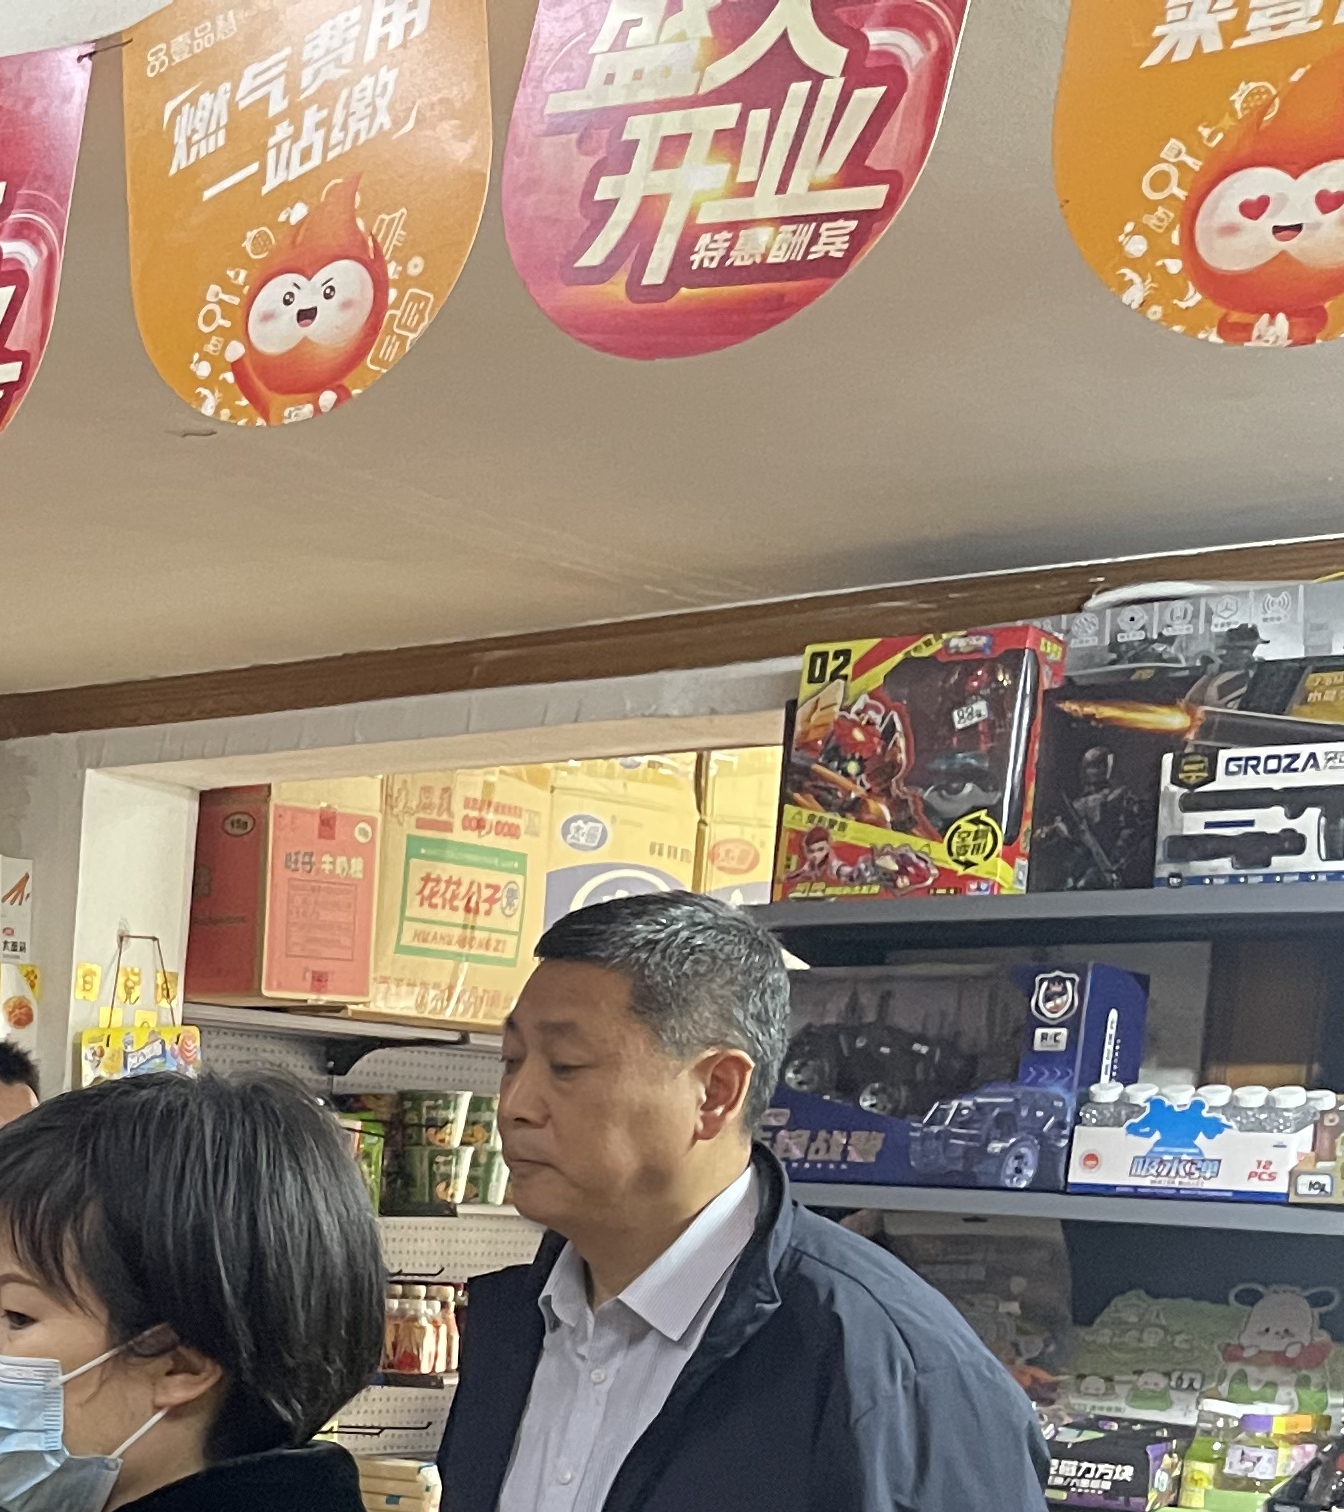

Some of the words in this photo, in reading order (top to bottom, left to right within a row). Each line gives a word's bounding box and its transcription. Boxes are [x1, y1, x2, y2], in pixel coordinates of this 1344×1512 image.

[574, 76, 891, 288] 开业
[688, 219, 860, 270] 特惠酬宾
[806, 649, 852, 684] 02
[1224, 751, 1321, 776] GROZA
[284, 851, 316, 874] 旺仔
[321, 853, 364, 879] 牛奶糖
[416, 871, 501, 916] 花花公子
[1247, 1170, 1278, 1183] PCS
